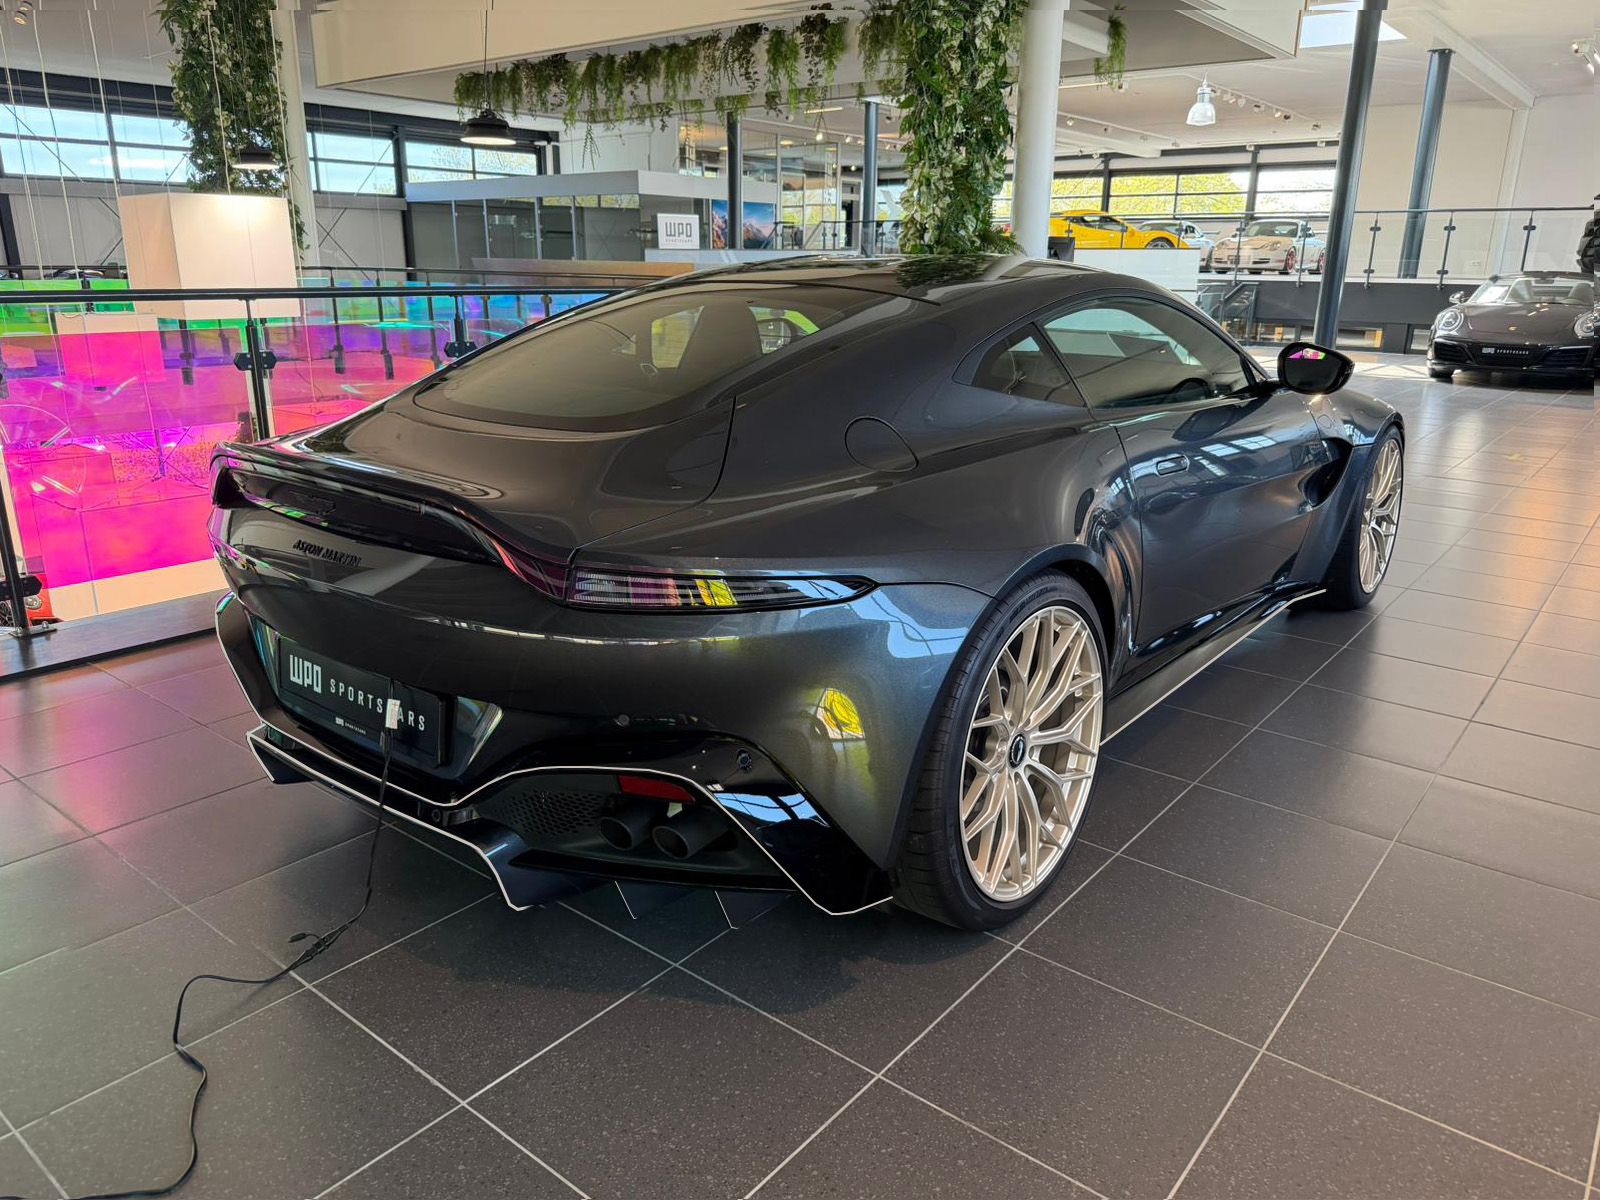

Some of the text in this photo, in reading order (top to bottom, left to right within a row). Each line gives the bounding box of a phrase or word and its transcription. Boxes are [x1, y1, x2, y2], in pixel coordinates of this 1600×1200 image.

[665, 222, 692, 237] WPO
[293, 540, 323, 557] ASTON
[289, 654, 322, 694] WPO
[330, 679, 425, 731] SPORTSARS
